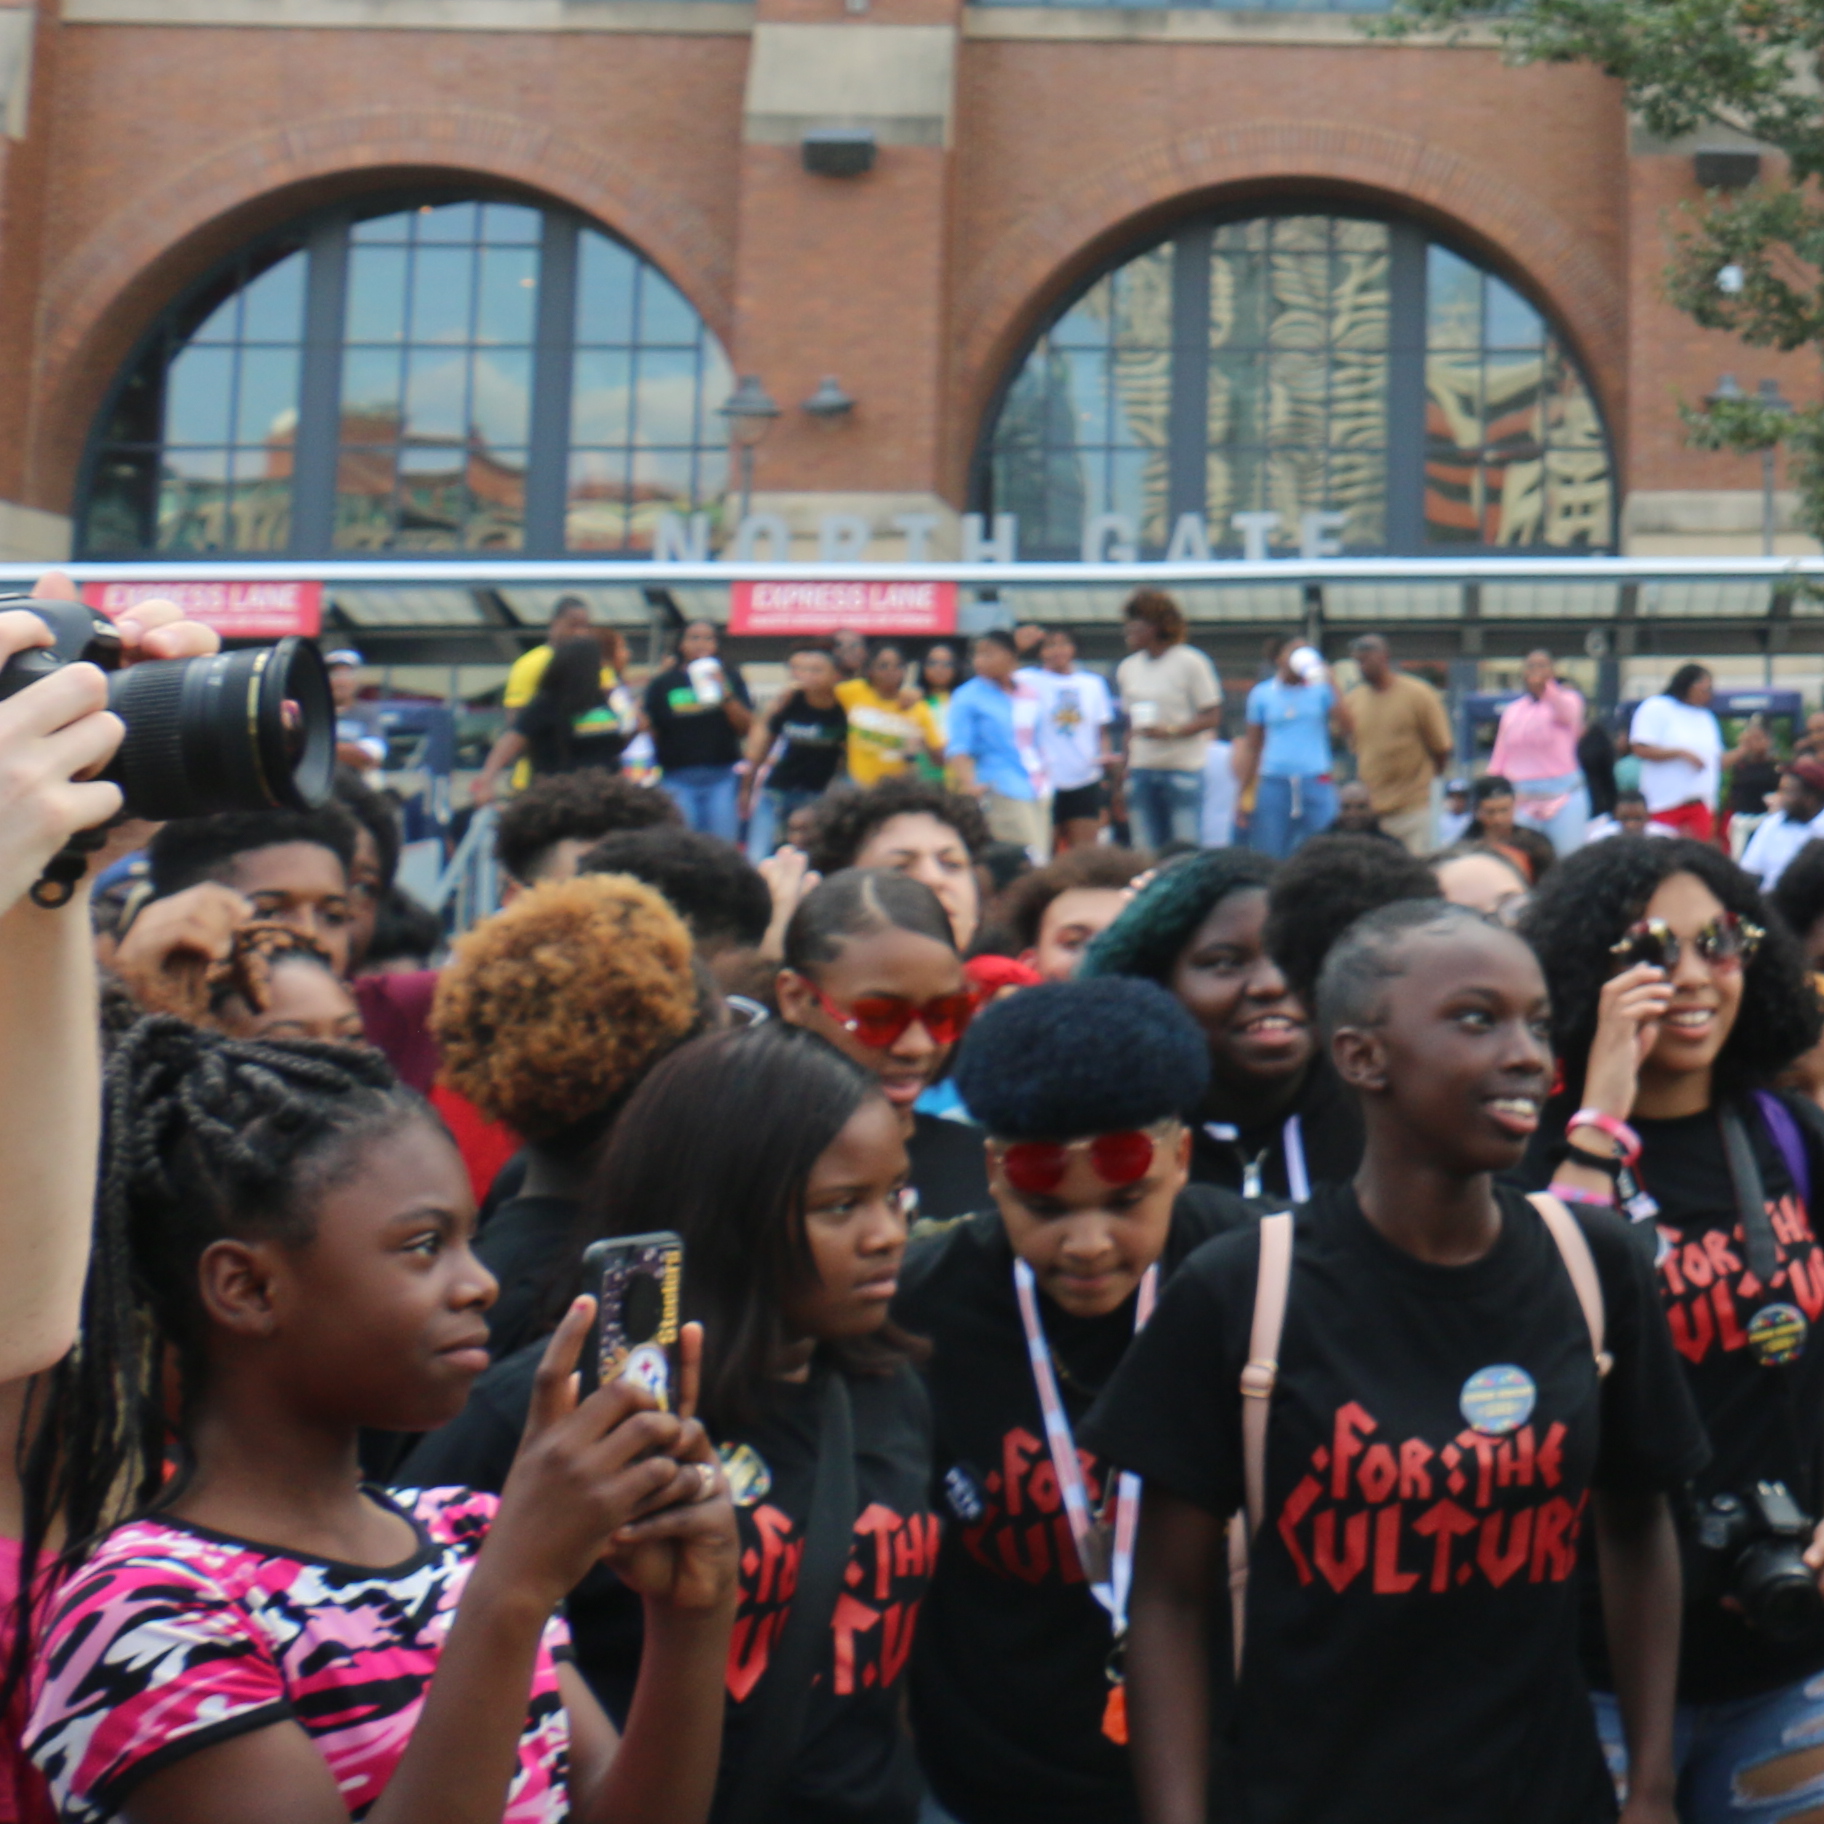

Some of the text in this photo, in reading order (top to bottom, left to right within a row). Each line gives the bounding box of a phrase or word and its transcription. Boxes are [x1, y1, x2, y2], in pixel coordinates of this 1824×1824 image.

[1080, 510, 1347, 562] GATE
[751, 582, 936, 613] EXPRESS LANE
